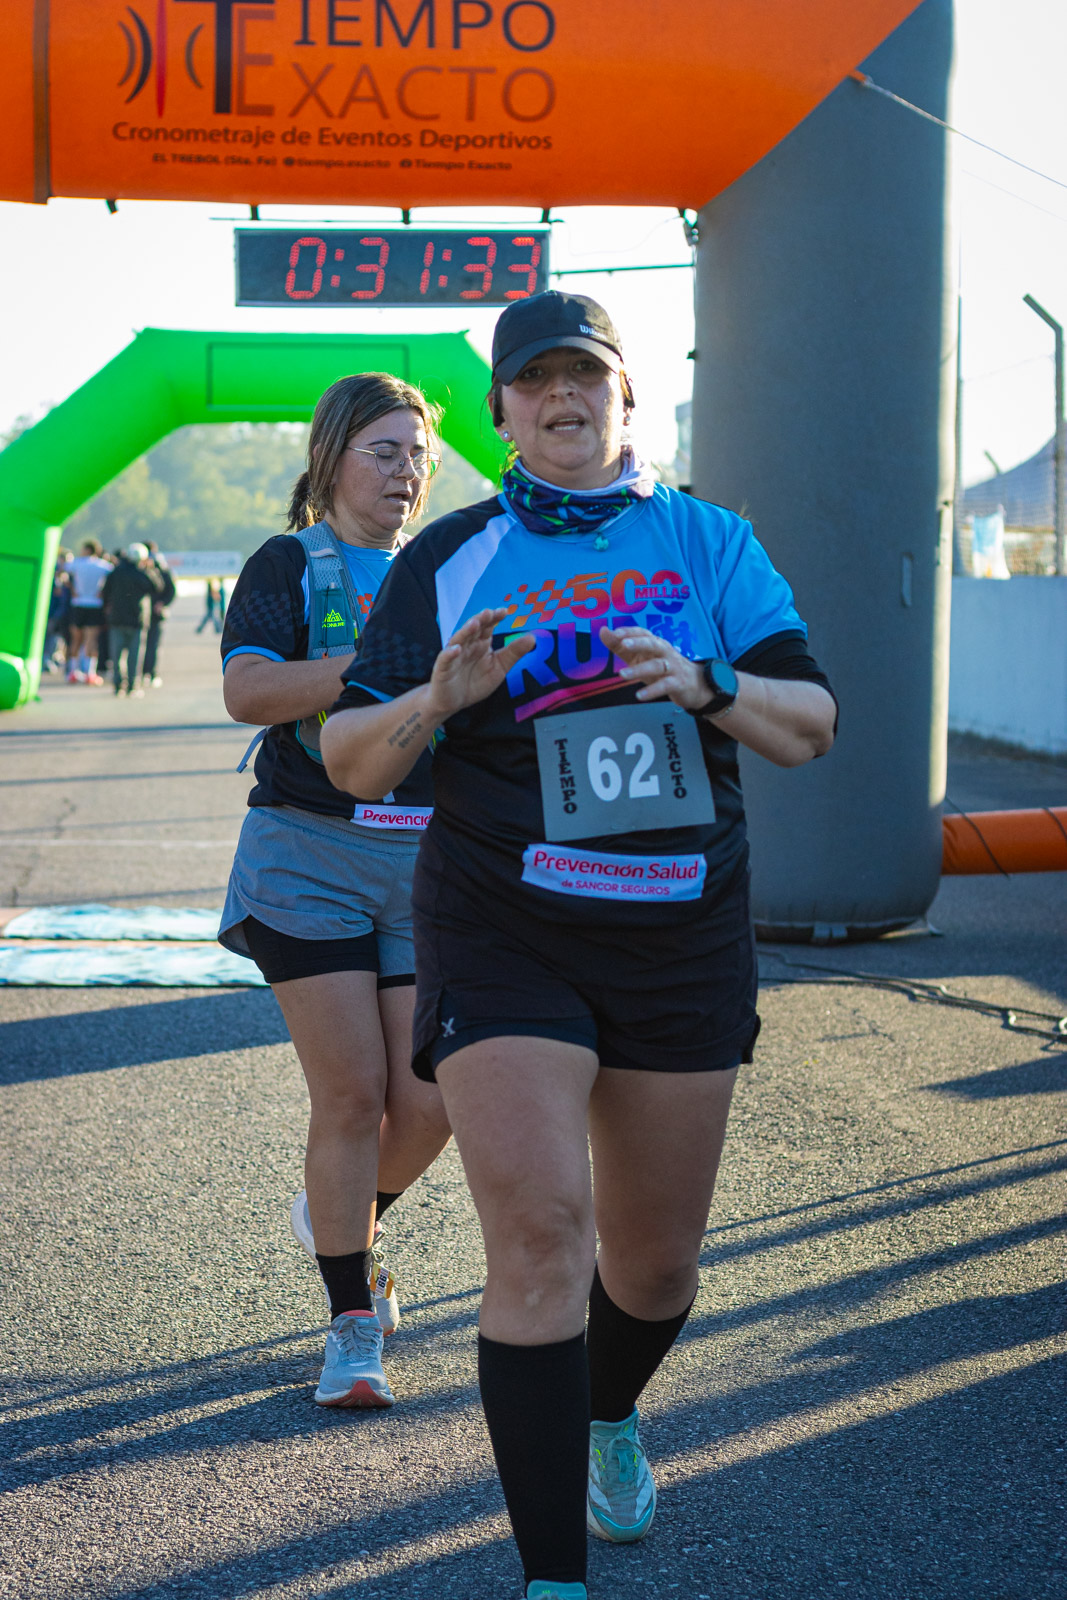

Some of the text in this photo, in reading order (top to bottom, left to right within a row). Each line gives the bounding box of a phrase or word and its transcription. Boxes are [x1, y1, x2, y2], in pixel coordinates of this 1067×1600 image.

[112, 121, 552, 152] Cronometraje de Eventos Deportivos
[153, 153, 167, 163] EL
[468, 158, 512, 171] Exacto
[570, 569, 684, 619] 500
[634, 585, 690, 600] MILLAS
[587, 732, 660, 802] 62
[663, 723, 687, 799] EXACTO
[554, 738, 577, 815] TIEMPO
[363, 809, 432, 827] Prevenci
[534, 851, 699, 880] Prevención Salud
[561, 880, 670, 896] de SANCOR SEGUROS
